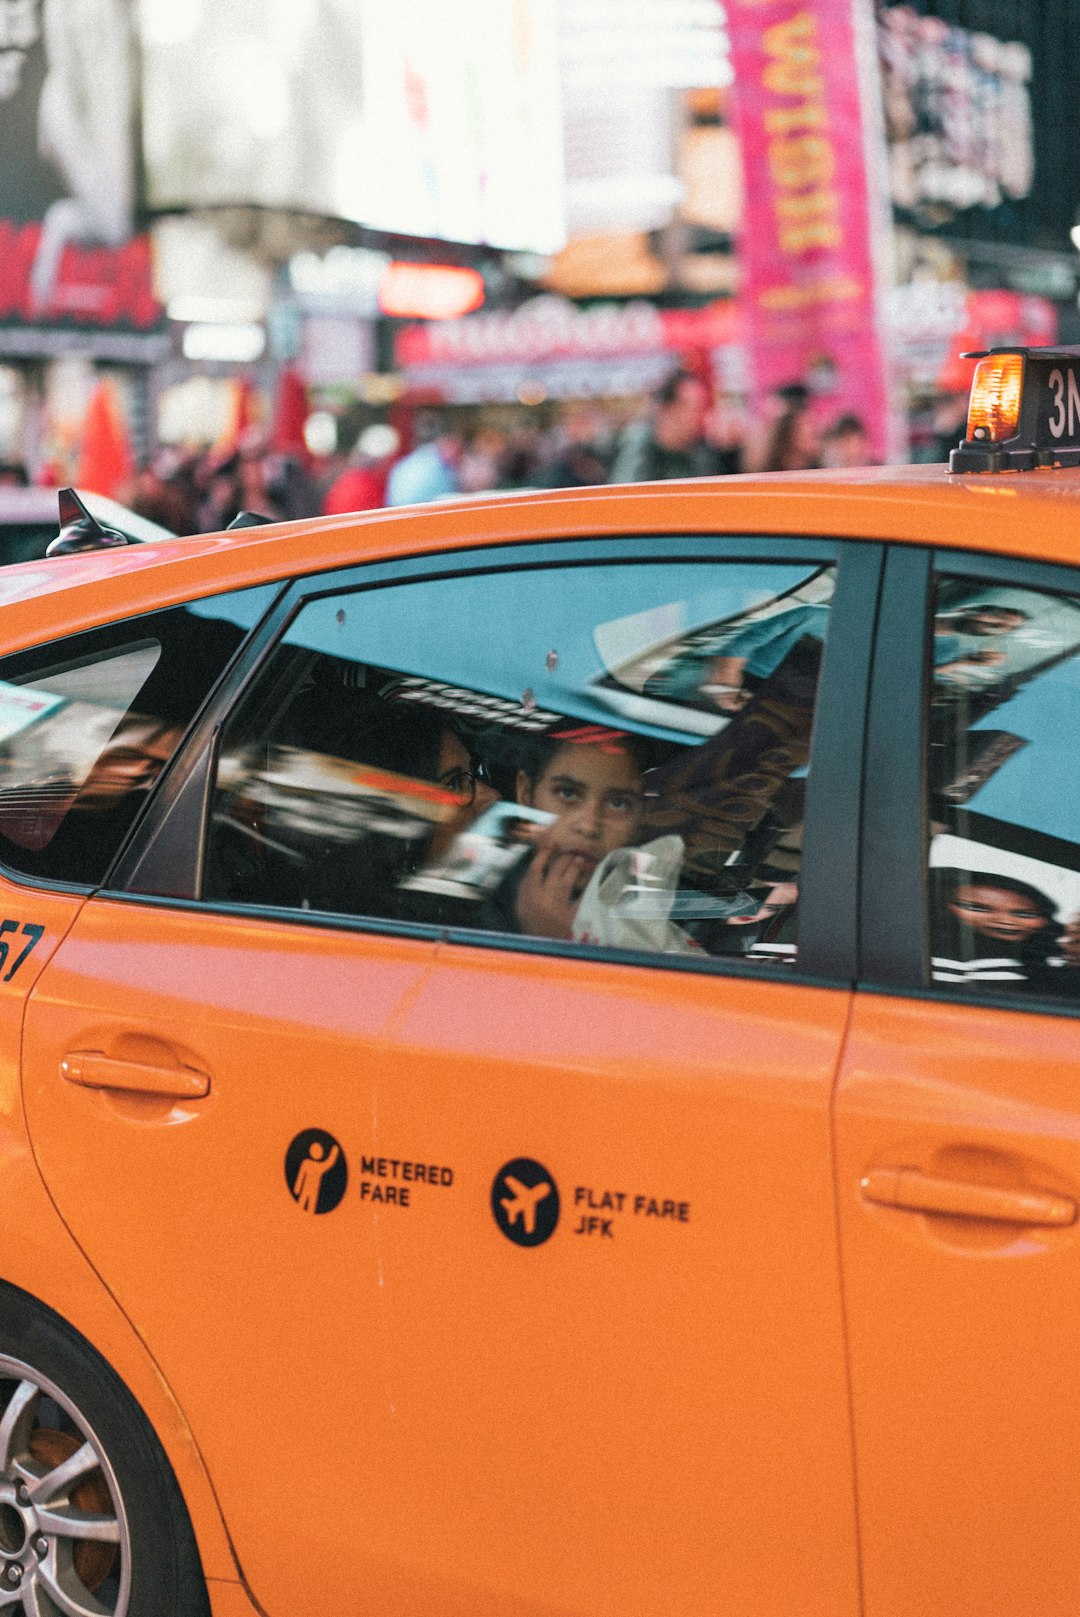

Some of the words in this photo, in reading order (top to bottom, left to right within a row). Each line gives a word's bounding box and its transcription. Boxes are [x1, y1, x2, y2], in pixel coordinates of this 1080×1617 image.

[0, 919, 46, 982] 57
[361, 1156, 454, 1187] METERED
[361, 1182, 410, 1207] FARE
[574, 1187, 626, 1212] FLAT
[634, 1195, 690, 1223] FARE
[574, 1216, 614, 1238] JFK
